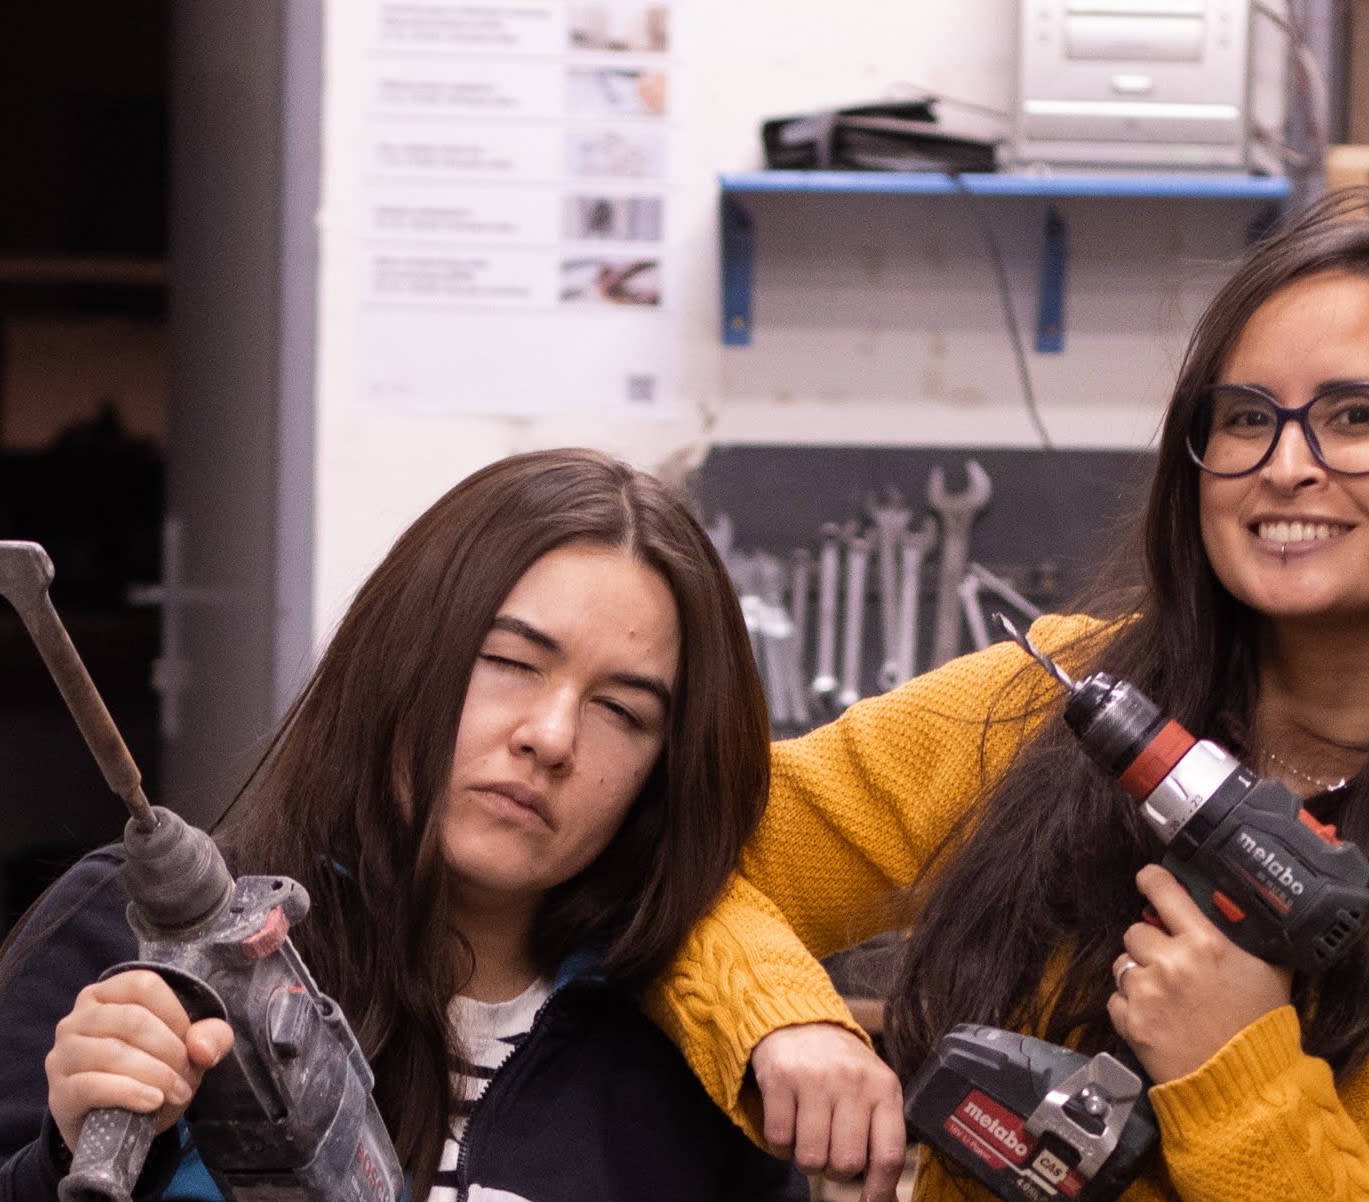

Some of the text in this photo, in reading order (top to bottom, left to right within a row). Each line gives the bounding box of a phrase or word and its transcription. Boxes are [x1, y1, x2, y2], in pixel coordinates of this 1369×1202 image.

[1239, 832, 1304, 895] metabo
[963, 1102, 1028, 1156] metabo
[1040, 1157, 1063, 1177] CAS
